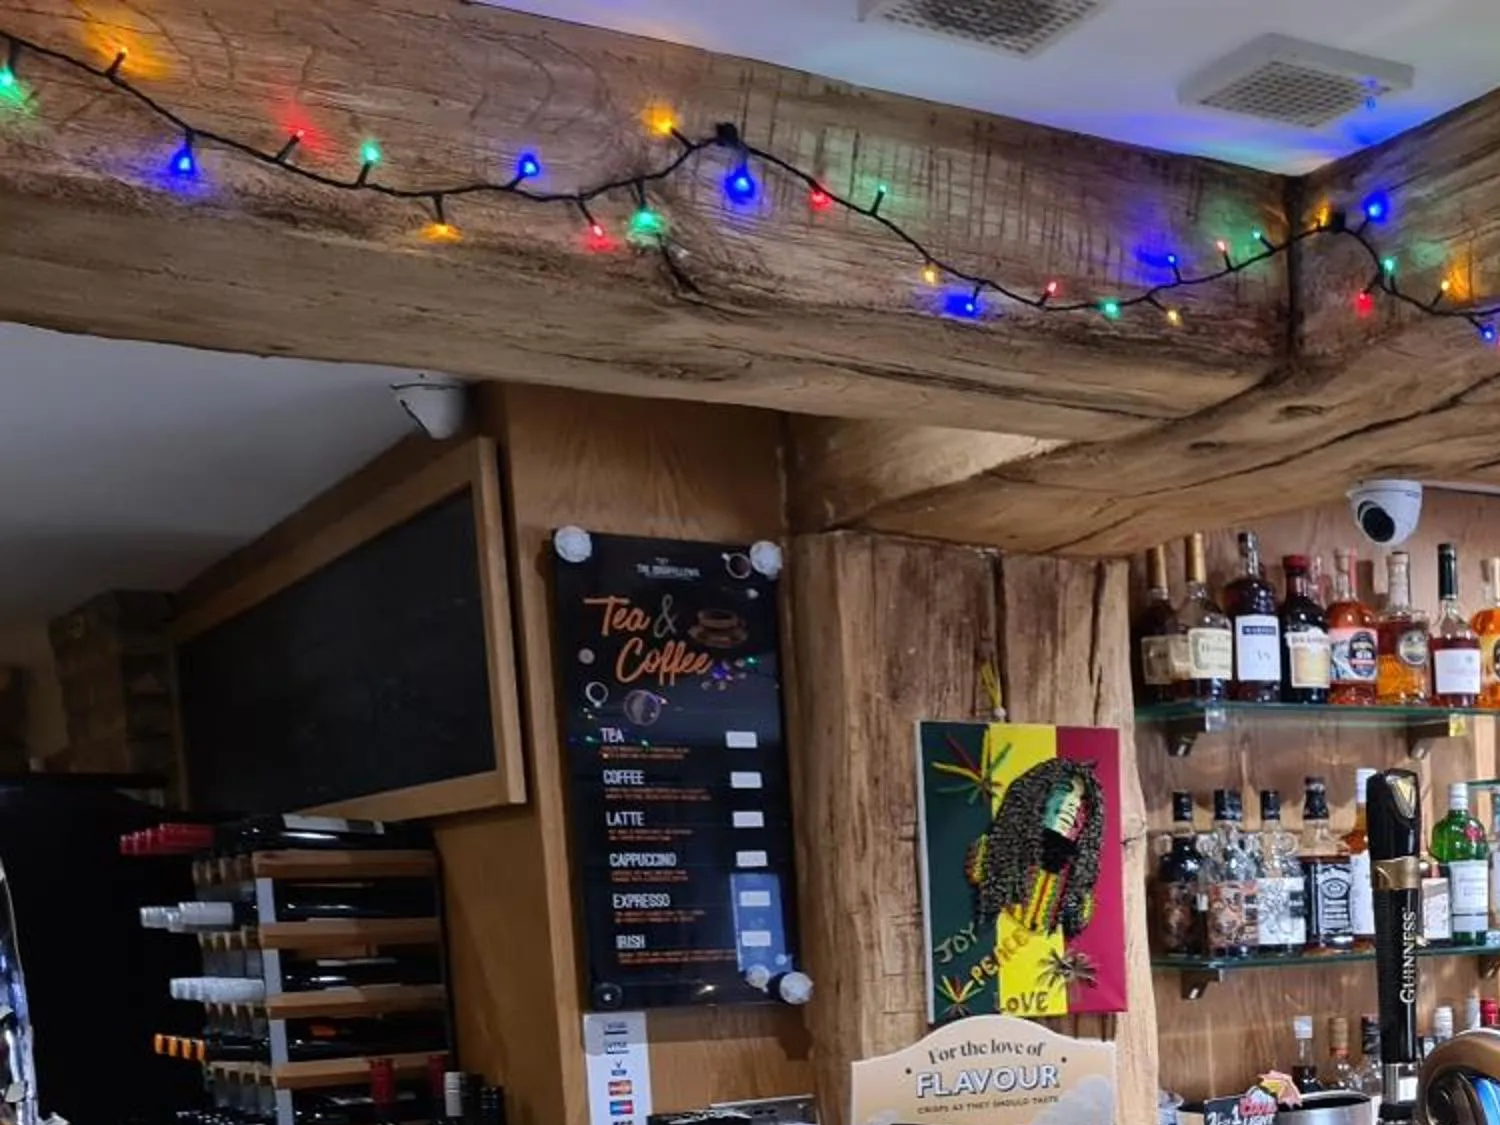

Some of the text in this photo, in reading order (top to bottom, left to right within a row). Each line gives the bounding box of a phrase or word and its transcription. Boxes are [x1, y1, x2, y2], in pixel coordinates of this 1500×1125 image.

[584, 594, 677, 638] Tea &
[616, 637, 713, 686] Coffee
[601, 727, 625, 743] TEA
[603, 769, 645, 785] COFFEE
[605, 811, 645, 827] LATTE
[609, 852, 677, 868] CAPPUCCINO
[612, 893, 671, 909] EXPRESSO
[616, 934, 646, 949] IRISH
[934, 922, 977, 964] JOY
[1399, 910, 1418, 1004] GUINNESS
[928, 1039, 1046, 1065] For the love of
[916, 1064, 1061, 1099] FLAVOUR
